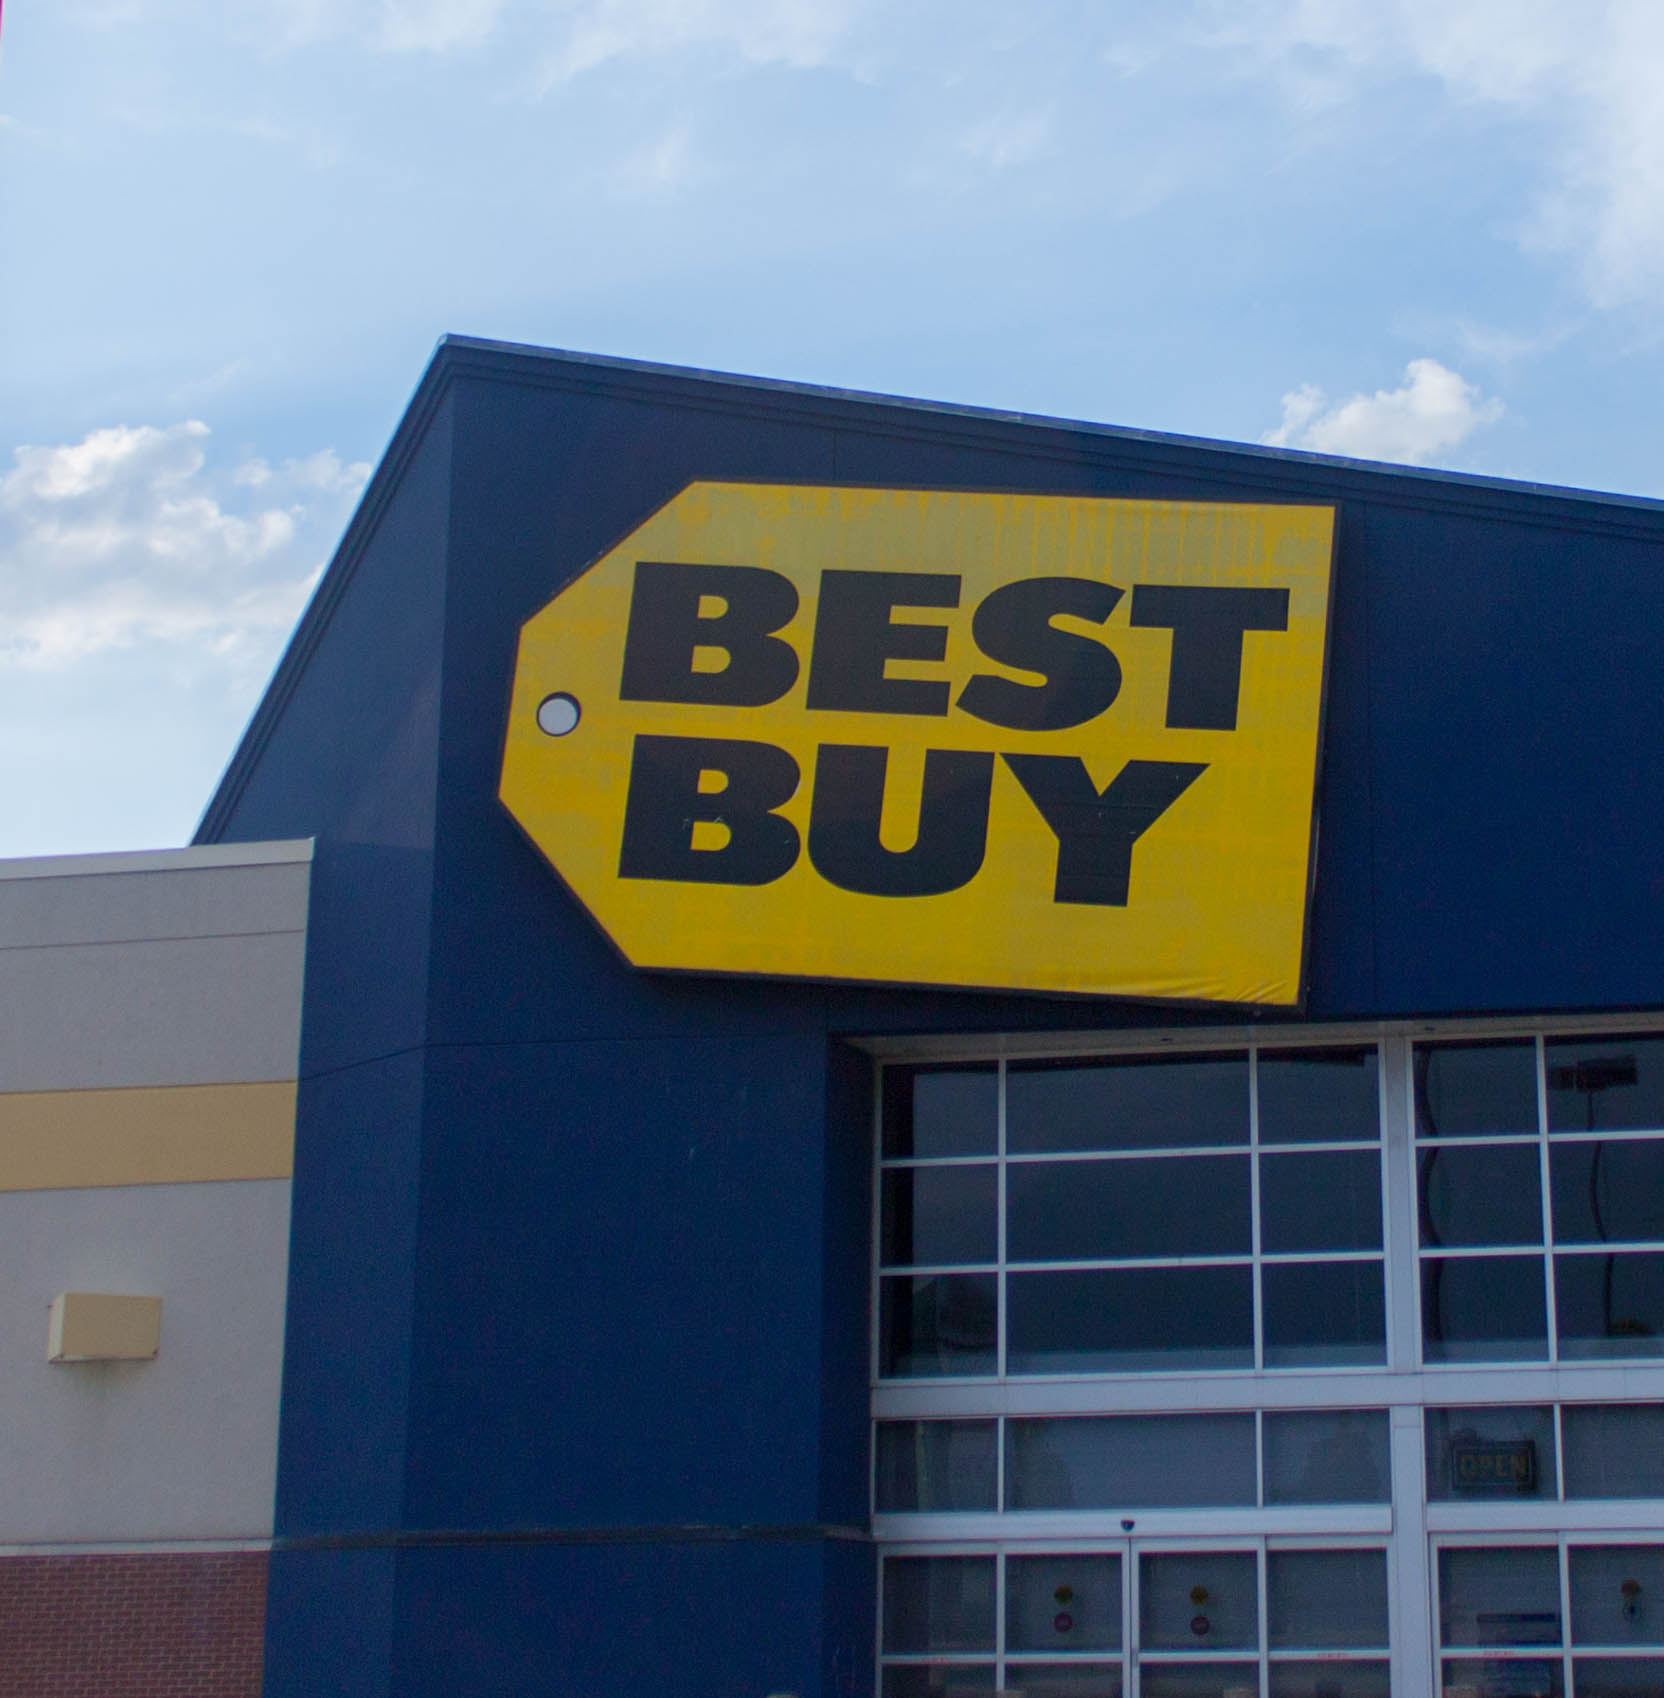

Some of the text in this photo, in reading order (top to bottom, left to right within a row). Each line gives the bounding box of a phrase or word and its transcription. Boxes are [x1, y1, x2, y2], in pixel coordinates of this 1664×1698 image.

[618, 561, 1289, 731] BEST
[618, 734, 1209, 907] BUY
[1459, 1454, 1527, 1477] OPEN
